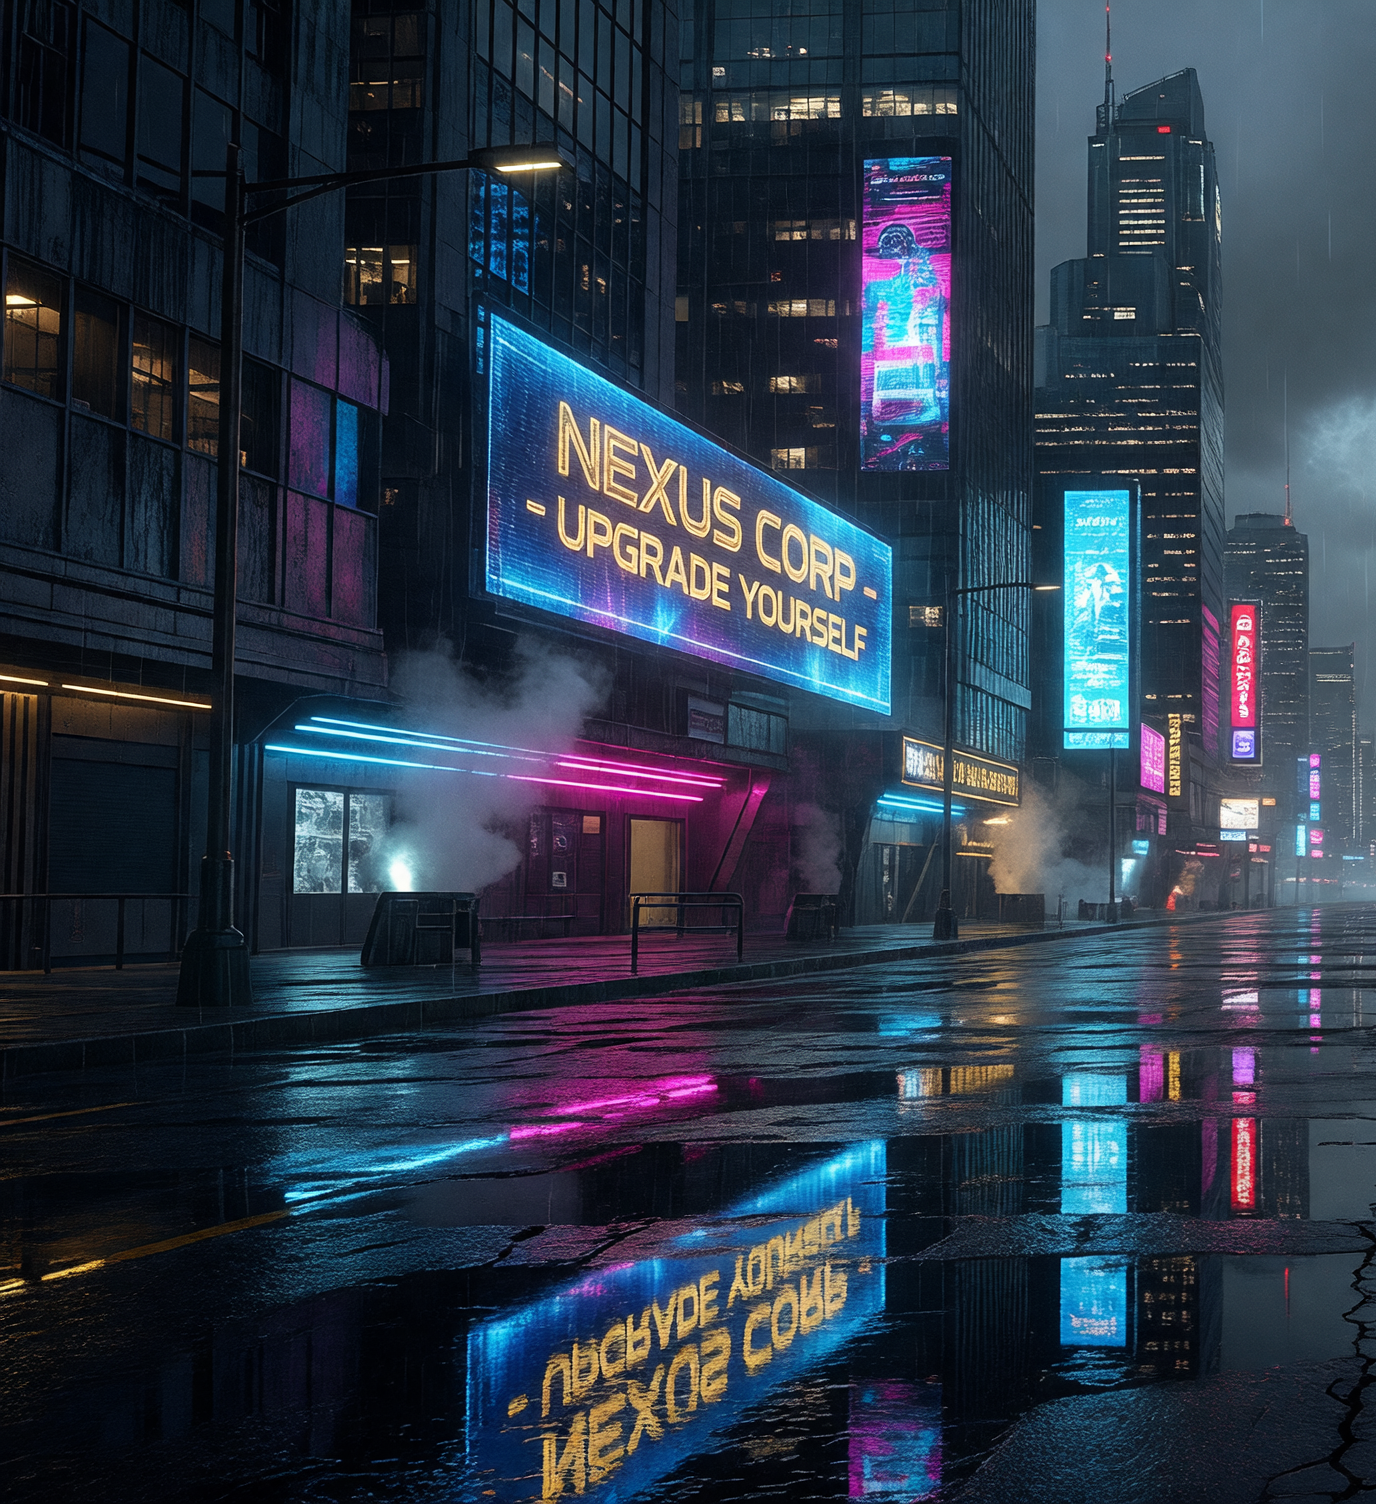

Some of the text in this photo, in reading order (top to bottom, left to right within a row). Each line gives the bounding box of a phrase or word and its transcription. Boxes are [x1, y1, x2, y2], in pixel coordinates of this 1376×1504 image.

[557, 400, 743, 552] NEXUS
[755, 508, 857, 602] CORP
[557, 496, 732, 611] UPGRADE
[738, 573, 868, 661] YOURSELF
